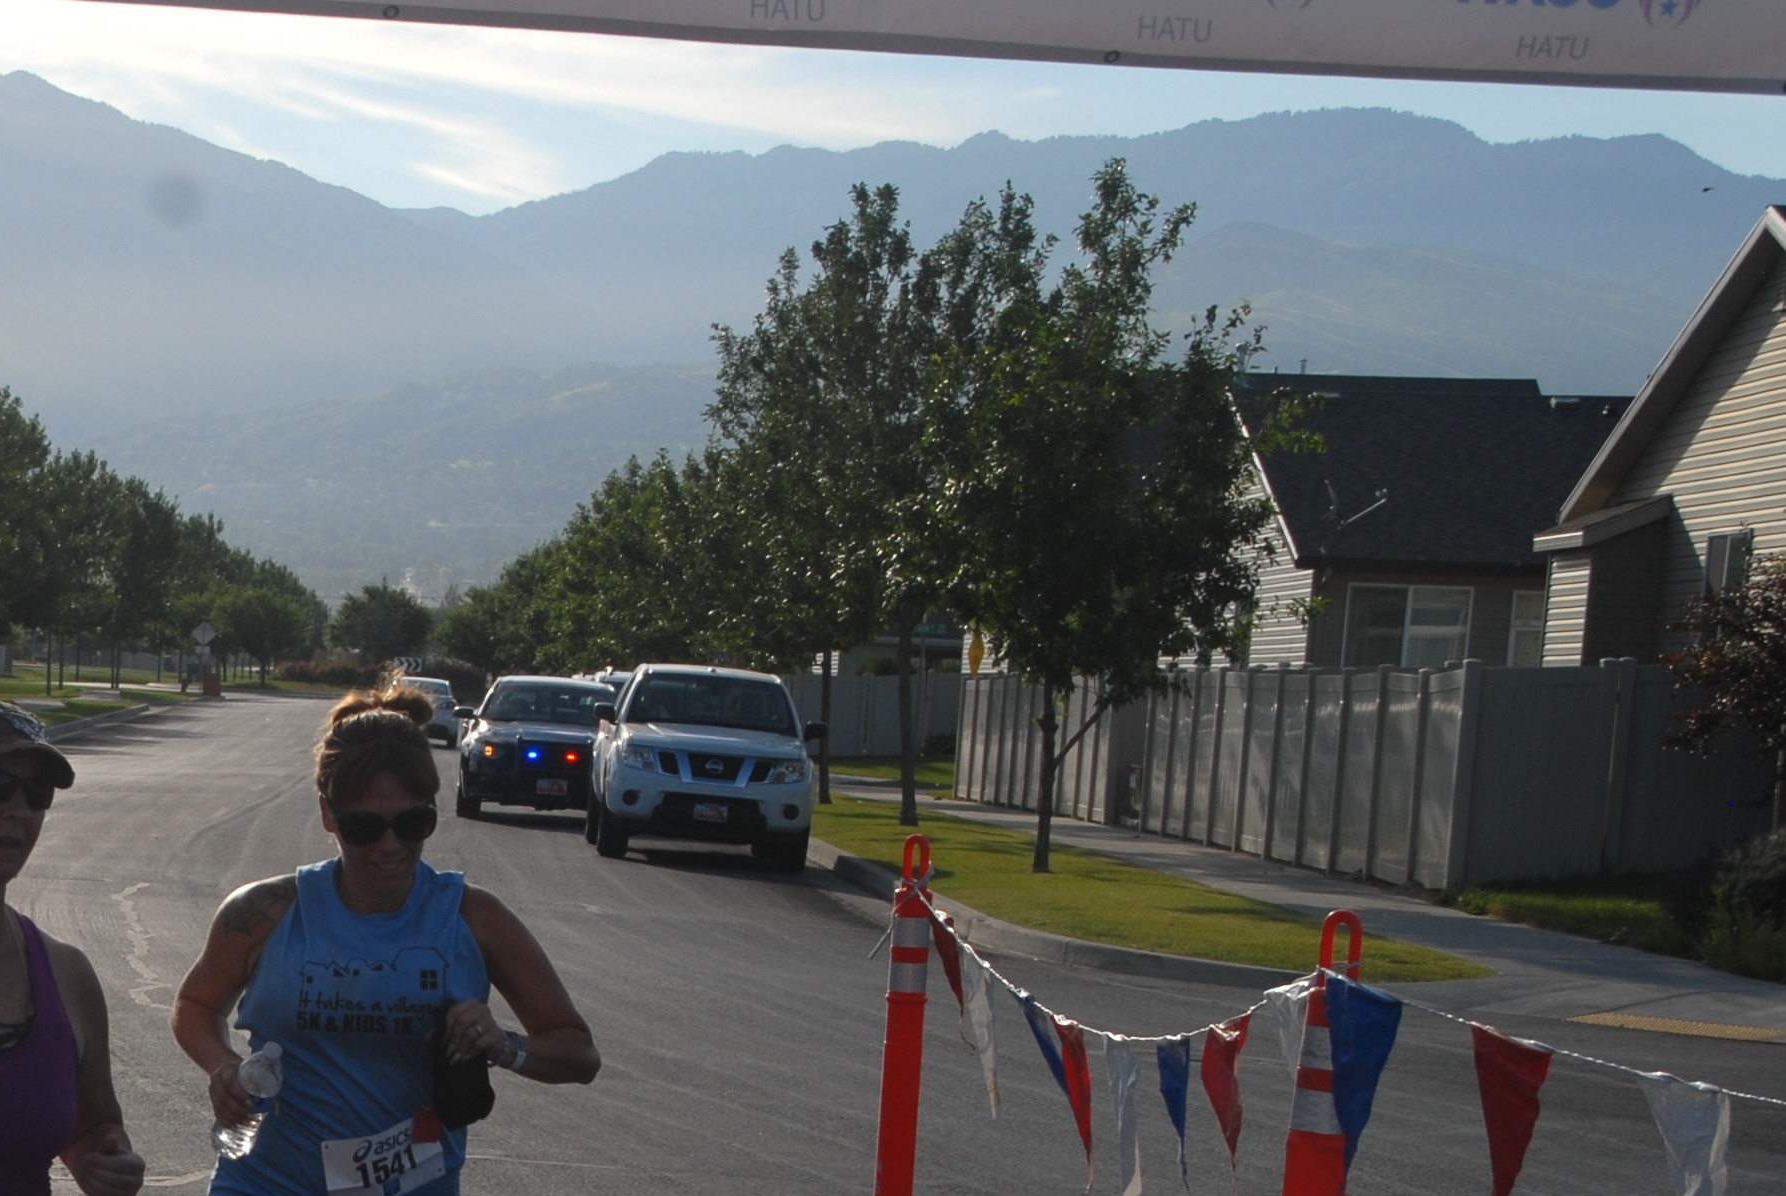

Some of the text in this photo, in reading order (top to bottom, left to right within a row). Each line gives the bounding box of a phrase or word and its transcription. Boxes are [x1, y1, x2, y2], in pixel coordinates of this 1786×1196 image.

[1137, 15, 1212, 43] HATU
[1516, 35, 1590, 60] HATU
[315, 991, 365, 1011] takes
[371, 1001, 382, 1013] a
[296, 1010, 414, 1036] 5K & KIDS 1K
[374, 1128, 411, 1155] asics
[356, 1144, 417, 1188] 1541
